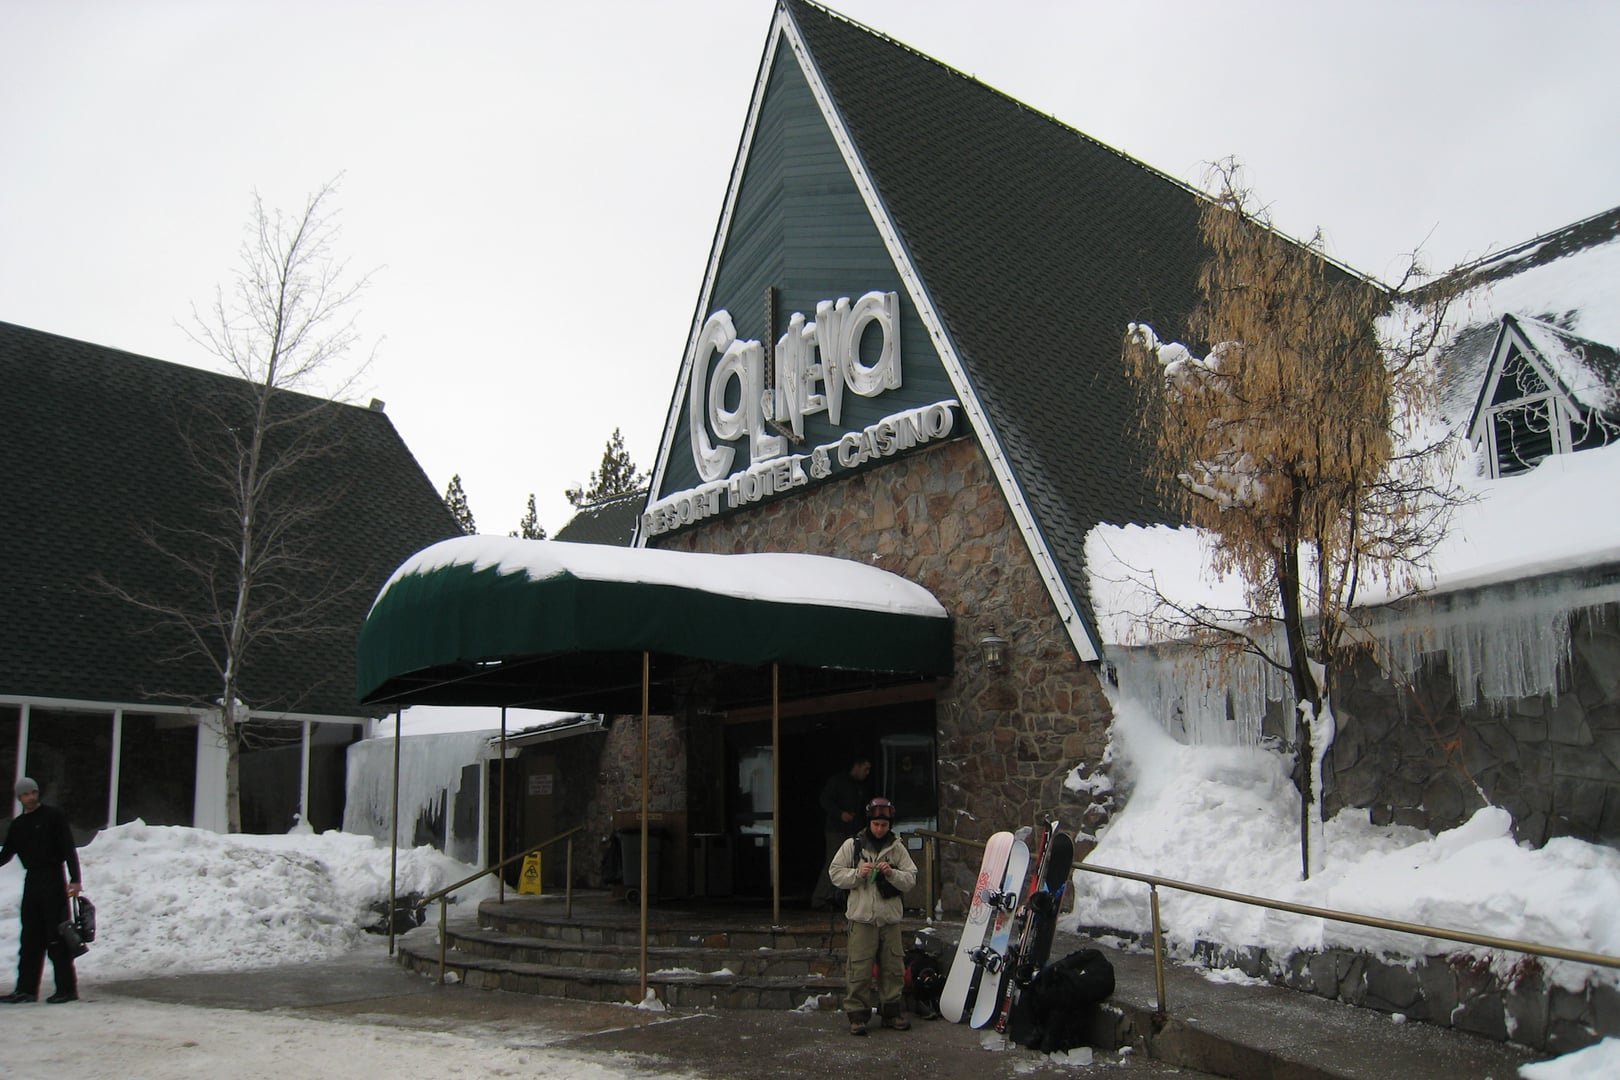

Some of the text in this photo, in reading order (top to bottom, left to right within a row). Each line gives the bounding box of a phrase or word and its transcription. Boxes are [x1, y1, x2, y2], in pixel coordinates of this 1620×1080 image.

[642, 404, 955, 537] RESORT HOTEL & CASINO
